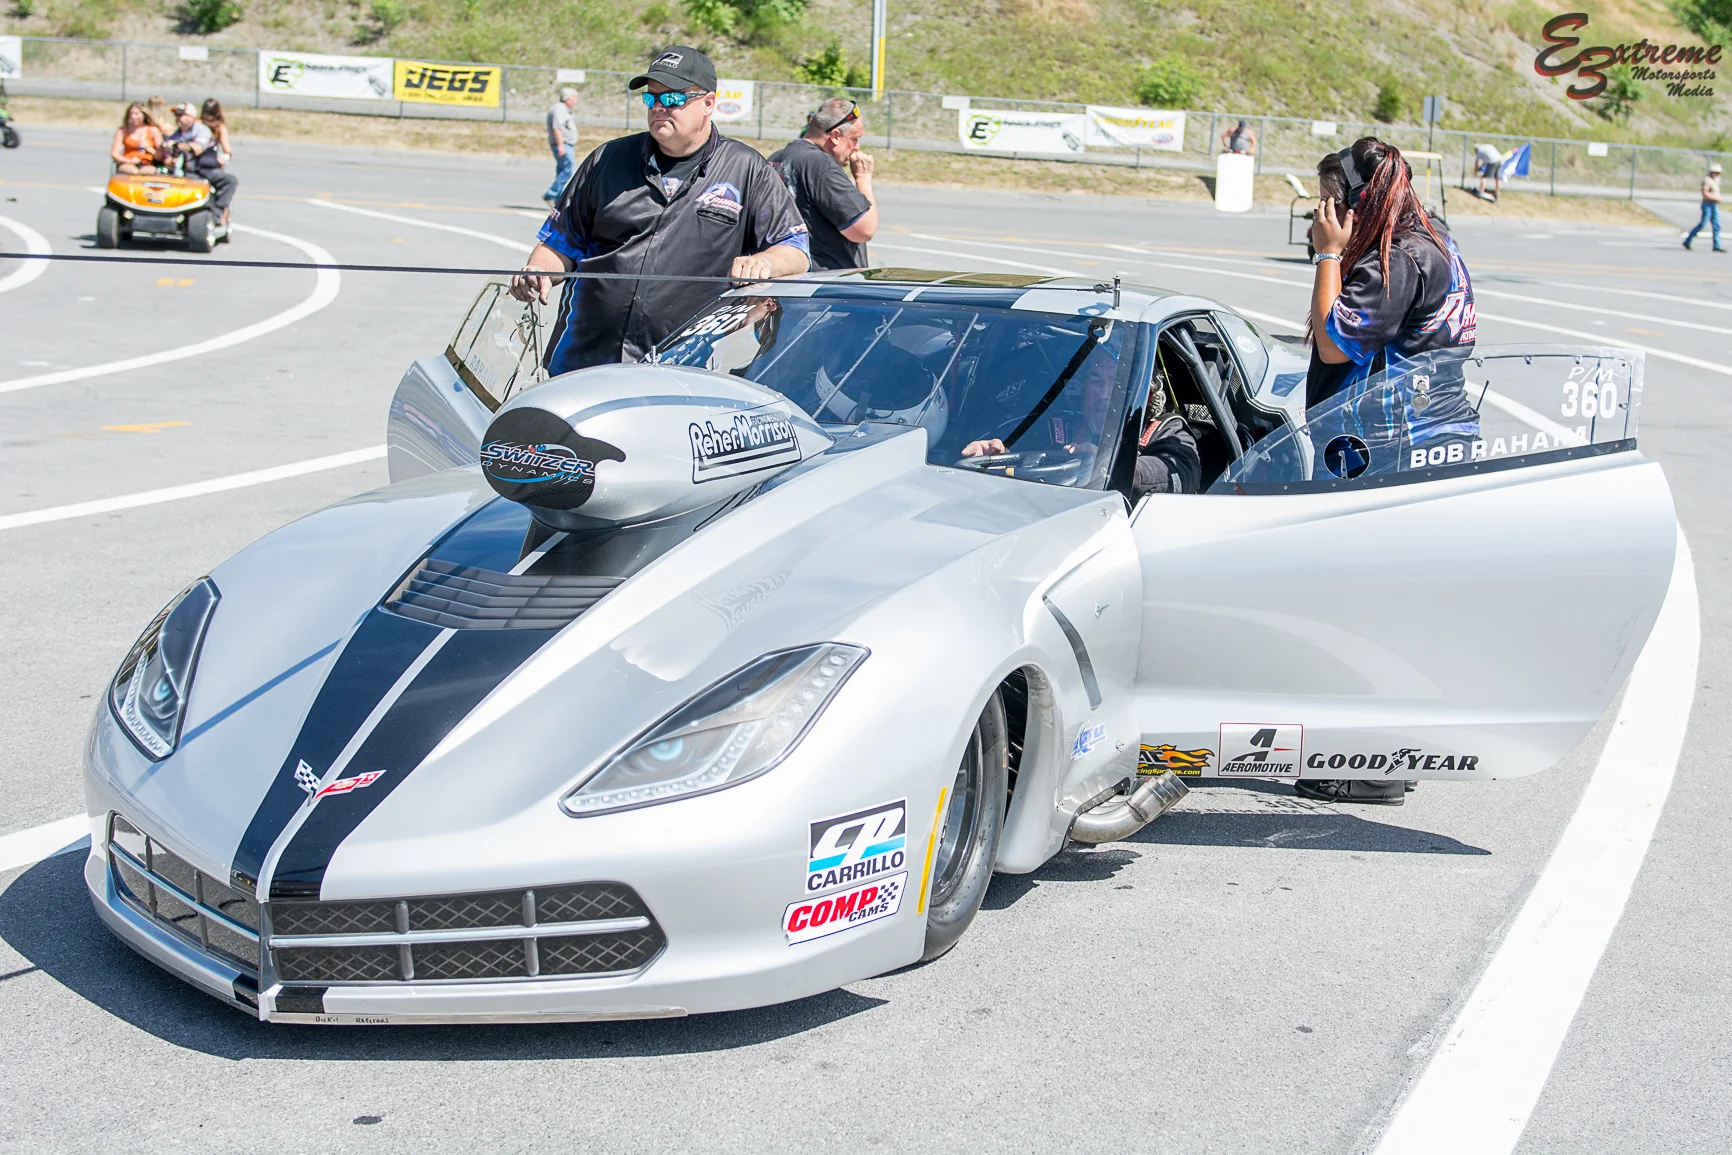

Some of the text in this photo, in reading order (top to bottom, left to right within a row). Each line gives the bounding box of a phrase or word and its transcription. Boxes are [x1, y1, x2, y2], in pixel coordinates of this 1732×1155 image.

[404, 67, 492, 93] JEGS
[680, 312, 748, 337] 360
[1568, 366, 1614, 384] P/M
[1561, 381, 1618, 419] 360
[1410, 443, 1464, 469] BOB
[482, 461, 593, 485] DYNAMICS
[1221, 763, 1294, 773] AEROMOTIVE
[807, 851, 905, 892] CARRILLO
[787, 886, 879, 933] COMP
[848, 902, 889, 923] CAMS
